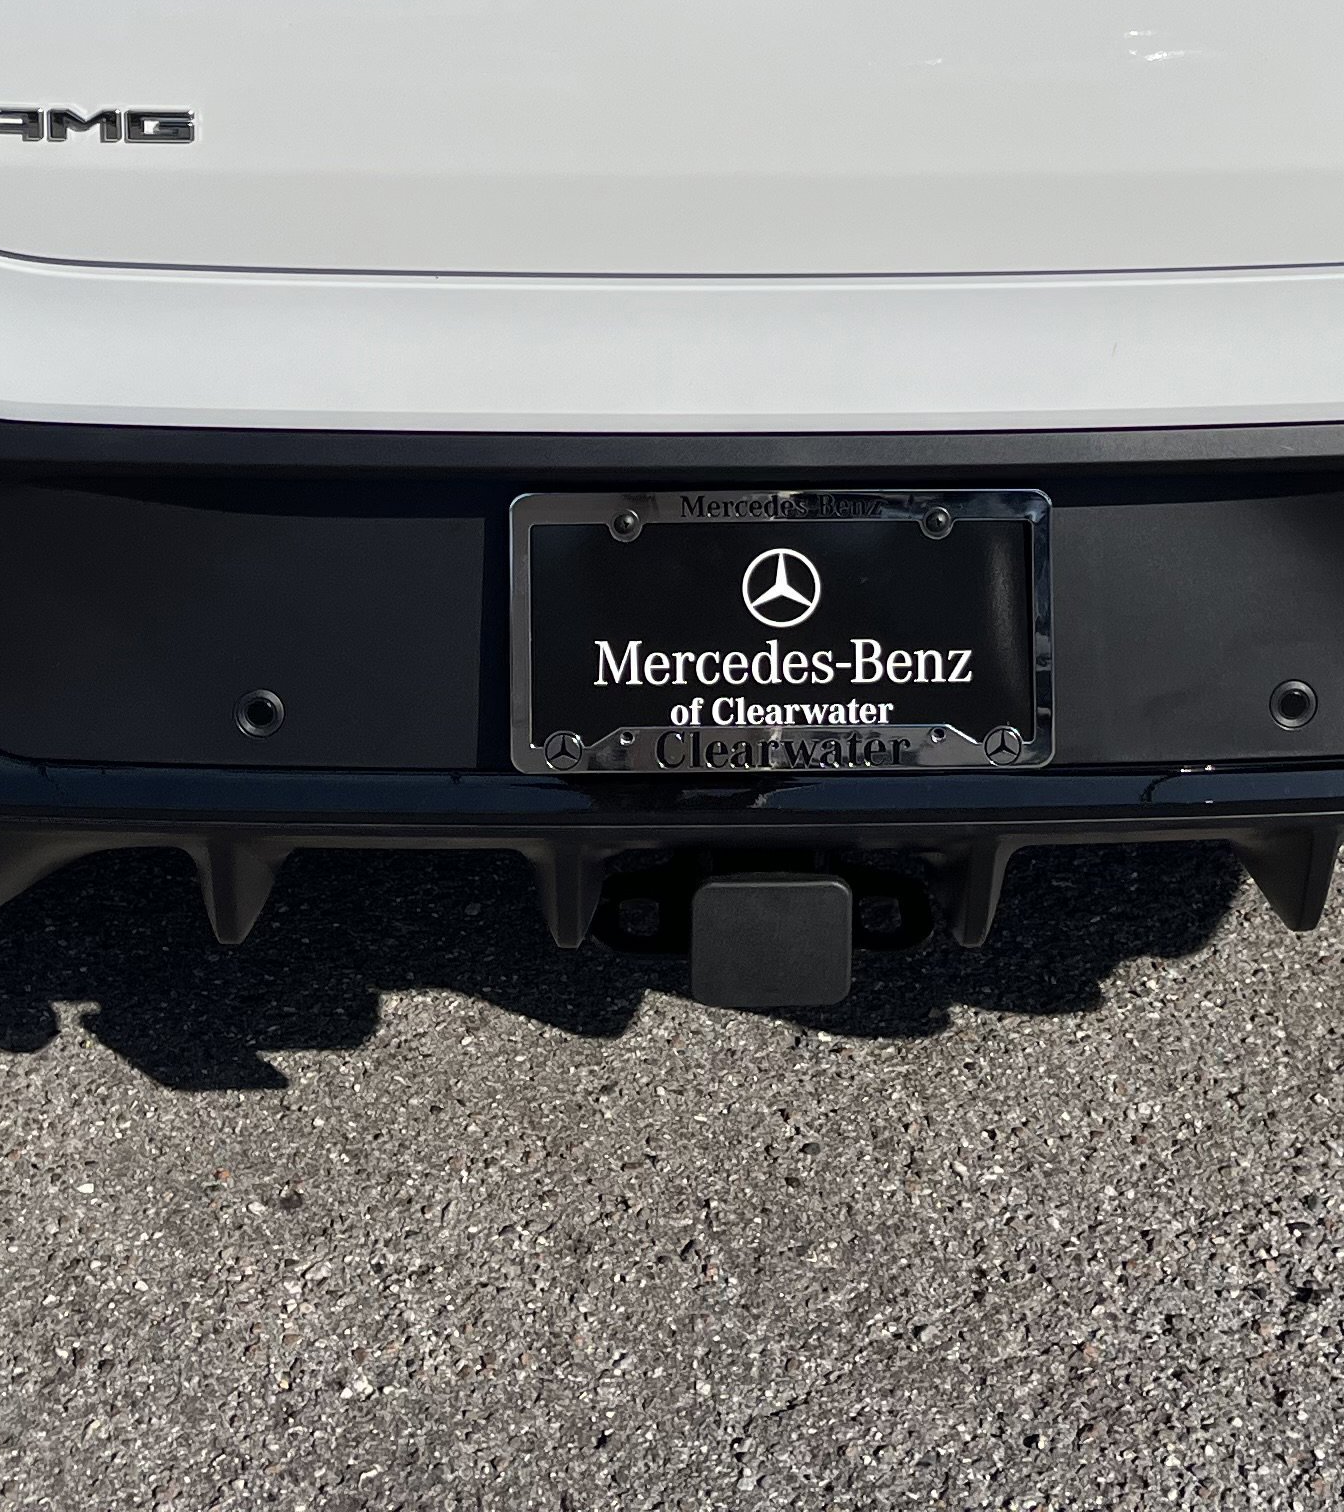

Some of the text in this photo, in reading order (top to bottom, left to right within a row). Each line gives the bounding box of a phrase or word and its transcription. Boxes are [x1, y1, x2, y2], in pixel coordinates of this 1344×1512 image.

[593, 638, 974, 687] Mercedes-Benz
[670, 696, 895, 727] of Clearwater
[656, 730, 912, 770] Clearwater
